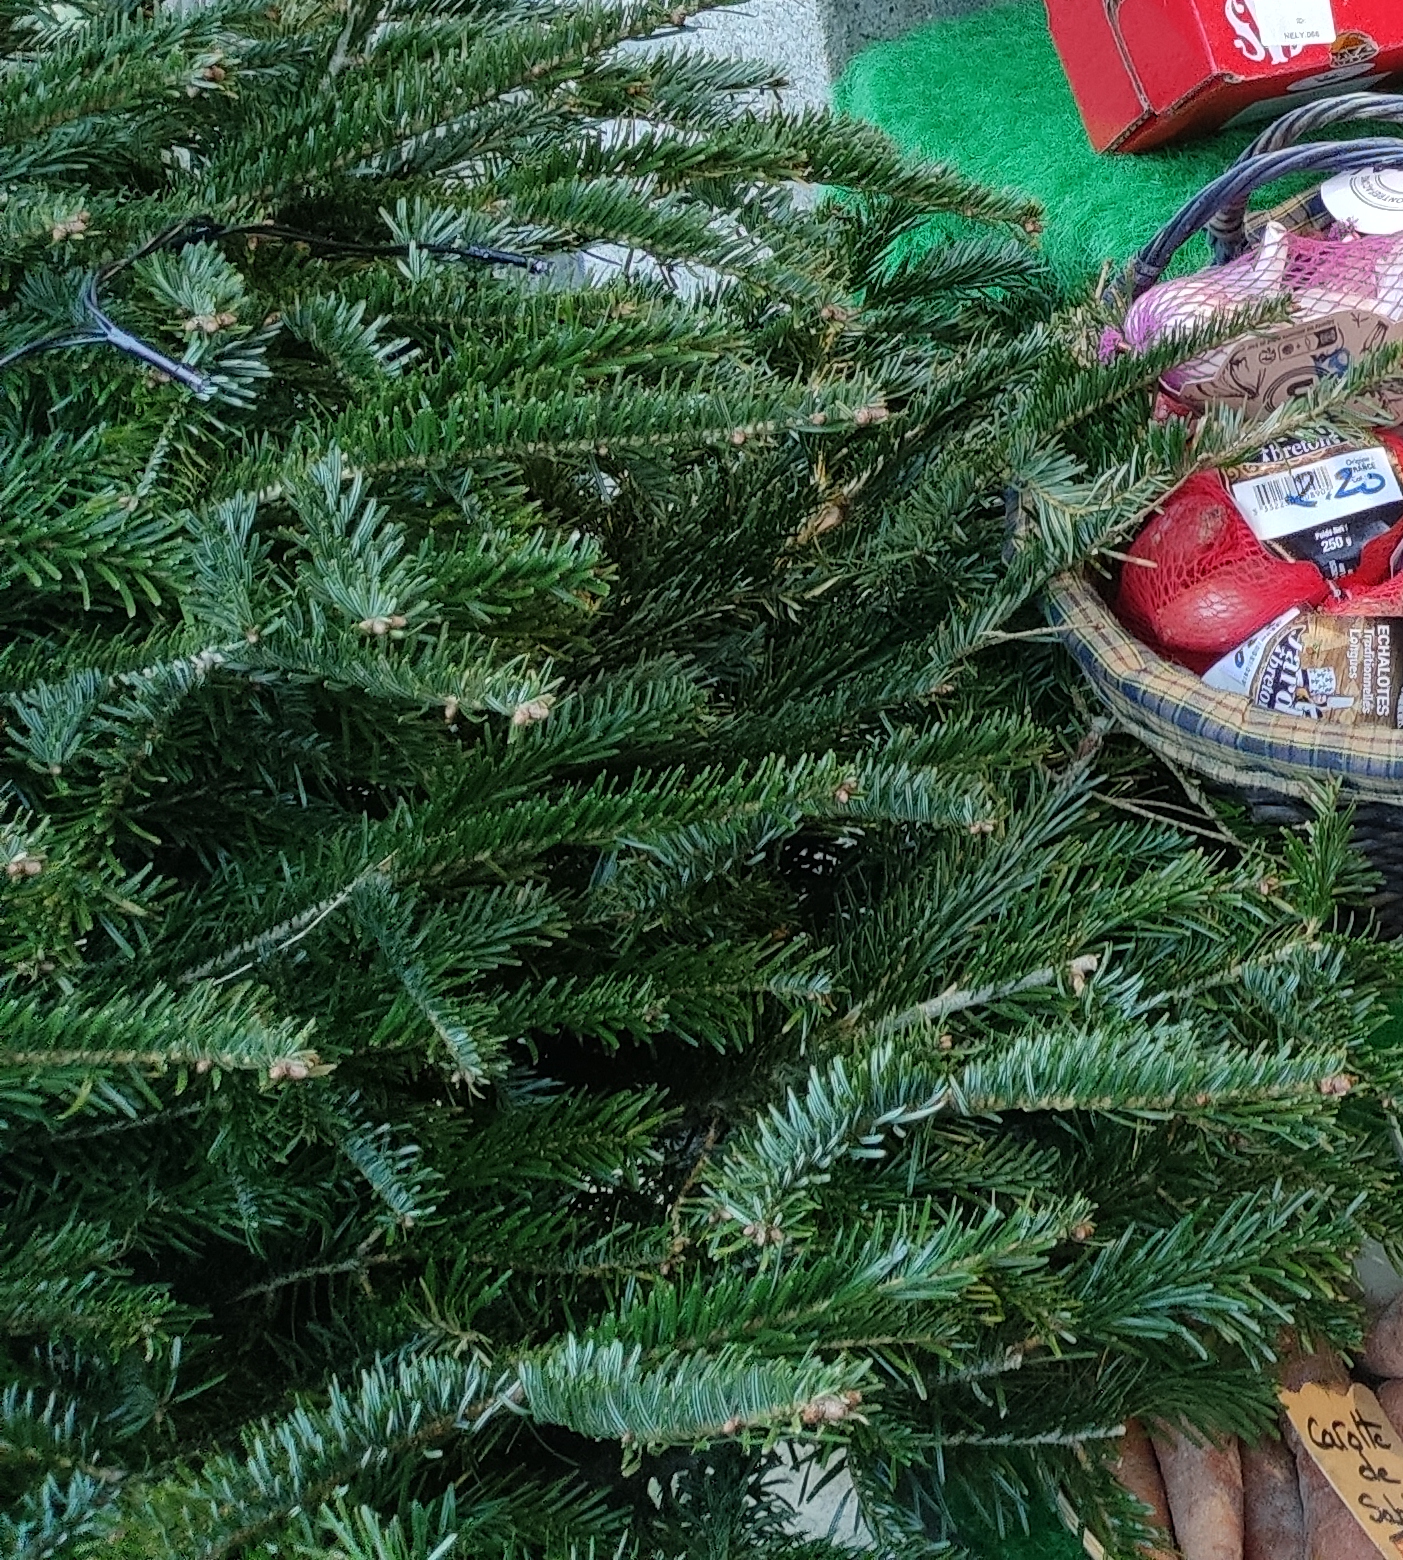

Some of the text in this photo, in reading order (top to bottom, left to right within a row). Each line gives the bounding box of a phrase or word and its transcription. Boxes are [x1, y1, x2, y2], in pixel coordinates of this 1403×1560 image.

[1320, 536, 1344, 555] 250
[1347, 628, 1359, 681] Longues
[1362, 628, 1374, 716] Traditionnelles
[1376, 624, 1392, 718] ECHALOTES
[1306, 1407, 1393, 1453] Carotte
[1357, 1450, 1401, 1485] de
